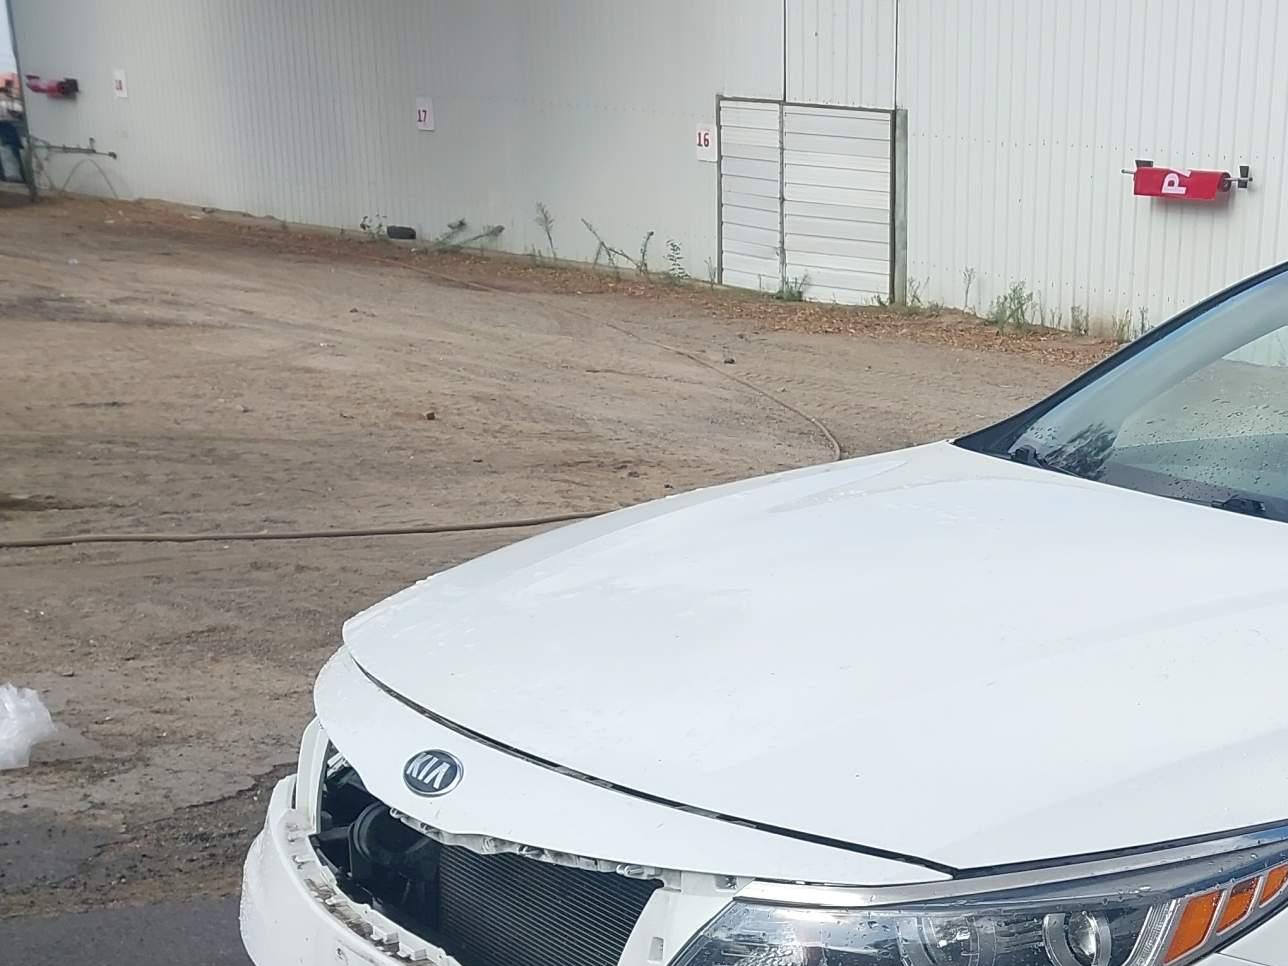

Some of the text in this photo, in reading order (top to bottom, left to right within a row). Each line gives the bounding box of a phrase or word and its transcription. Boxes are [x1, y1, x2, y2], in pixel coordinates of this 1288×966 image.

[417, 109, 427, 123] 17
[697, 132, 710, 147] 16
[406, 752, 451, 789] KIA
